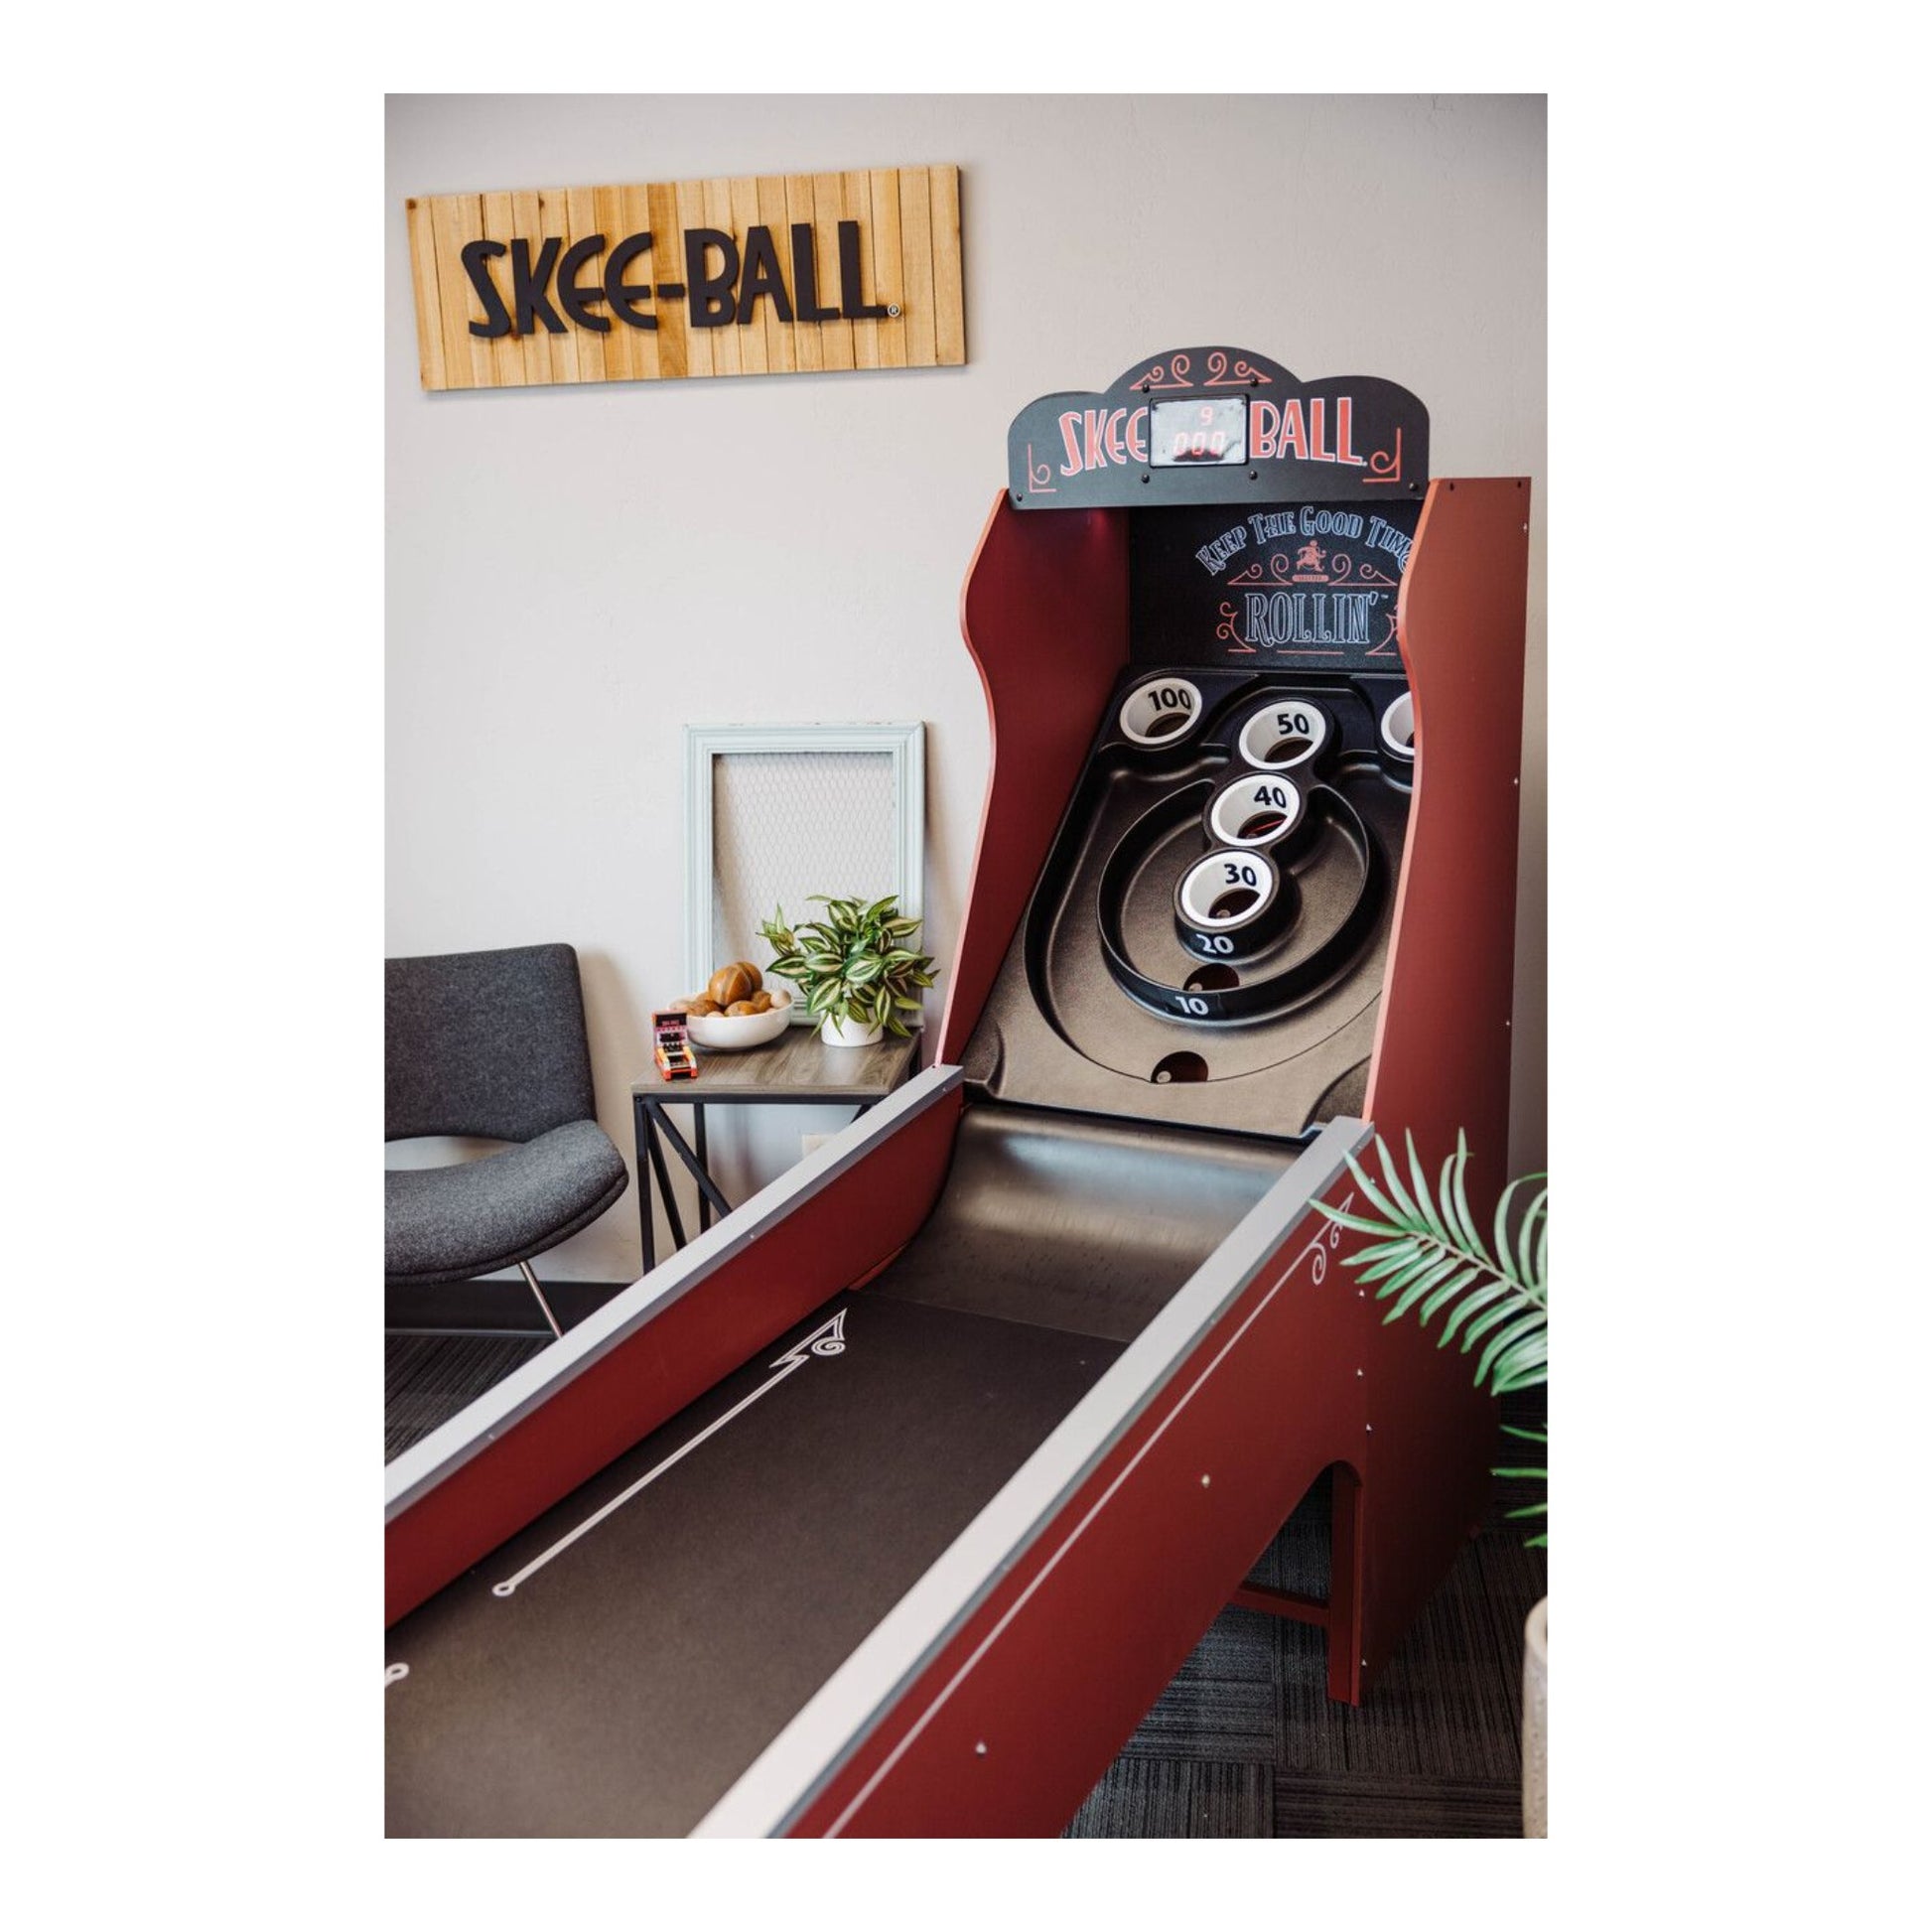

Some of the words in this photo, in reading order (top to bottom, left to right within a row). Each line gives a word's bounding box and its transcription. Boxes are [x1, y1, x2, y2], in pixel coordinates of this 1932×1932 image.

[1058, 406, 1149, 476] SKEE
[1250, 397, 1363, 466] BALL
[1195, 525, 1247, 576] KEEP
[1248, 512, 1297, 545] THE
[1300, 506, 1363, 539] GOOD
[1245, 591, 1379, 647] ROLLIN'
[1148, 687, 1191, 711] 100
[1277, 713, 1311, 736] 50
[1254, 785, 1287, 809] 40
[1224, 863, 1257, 887] 30
[1196, 933, 1234, 955] 20
[1175, 996, 1209, 1017] 10
